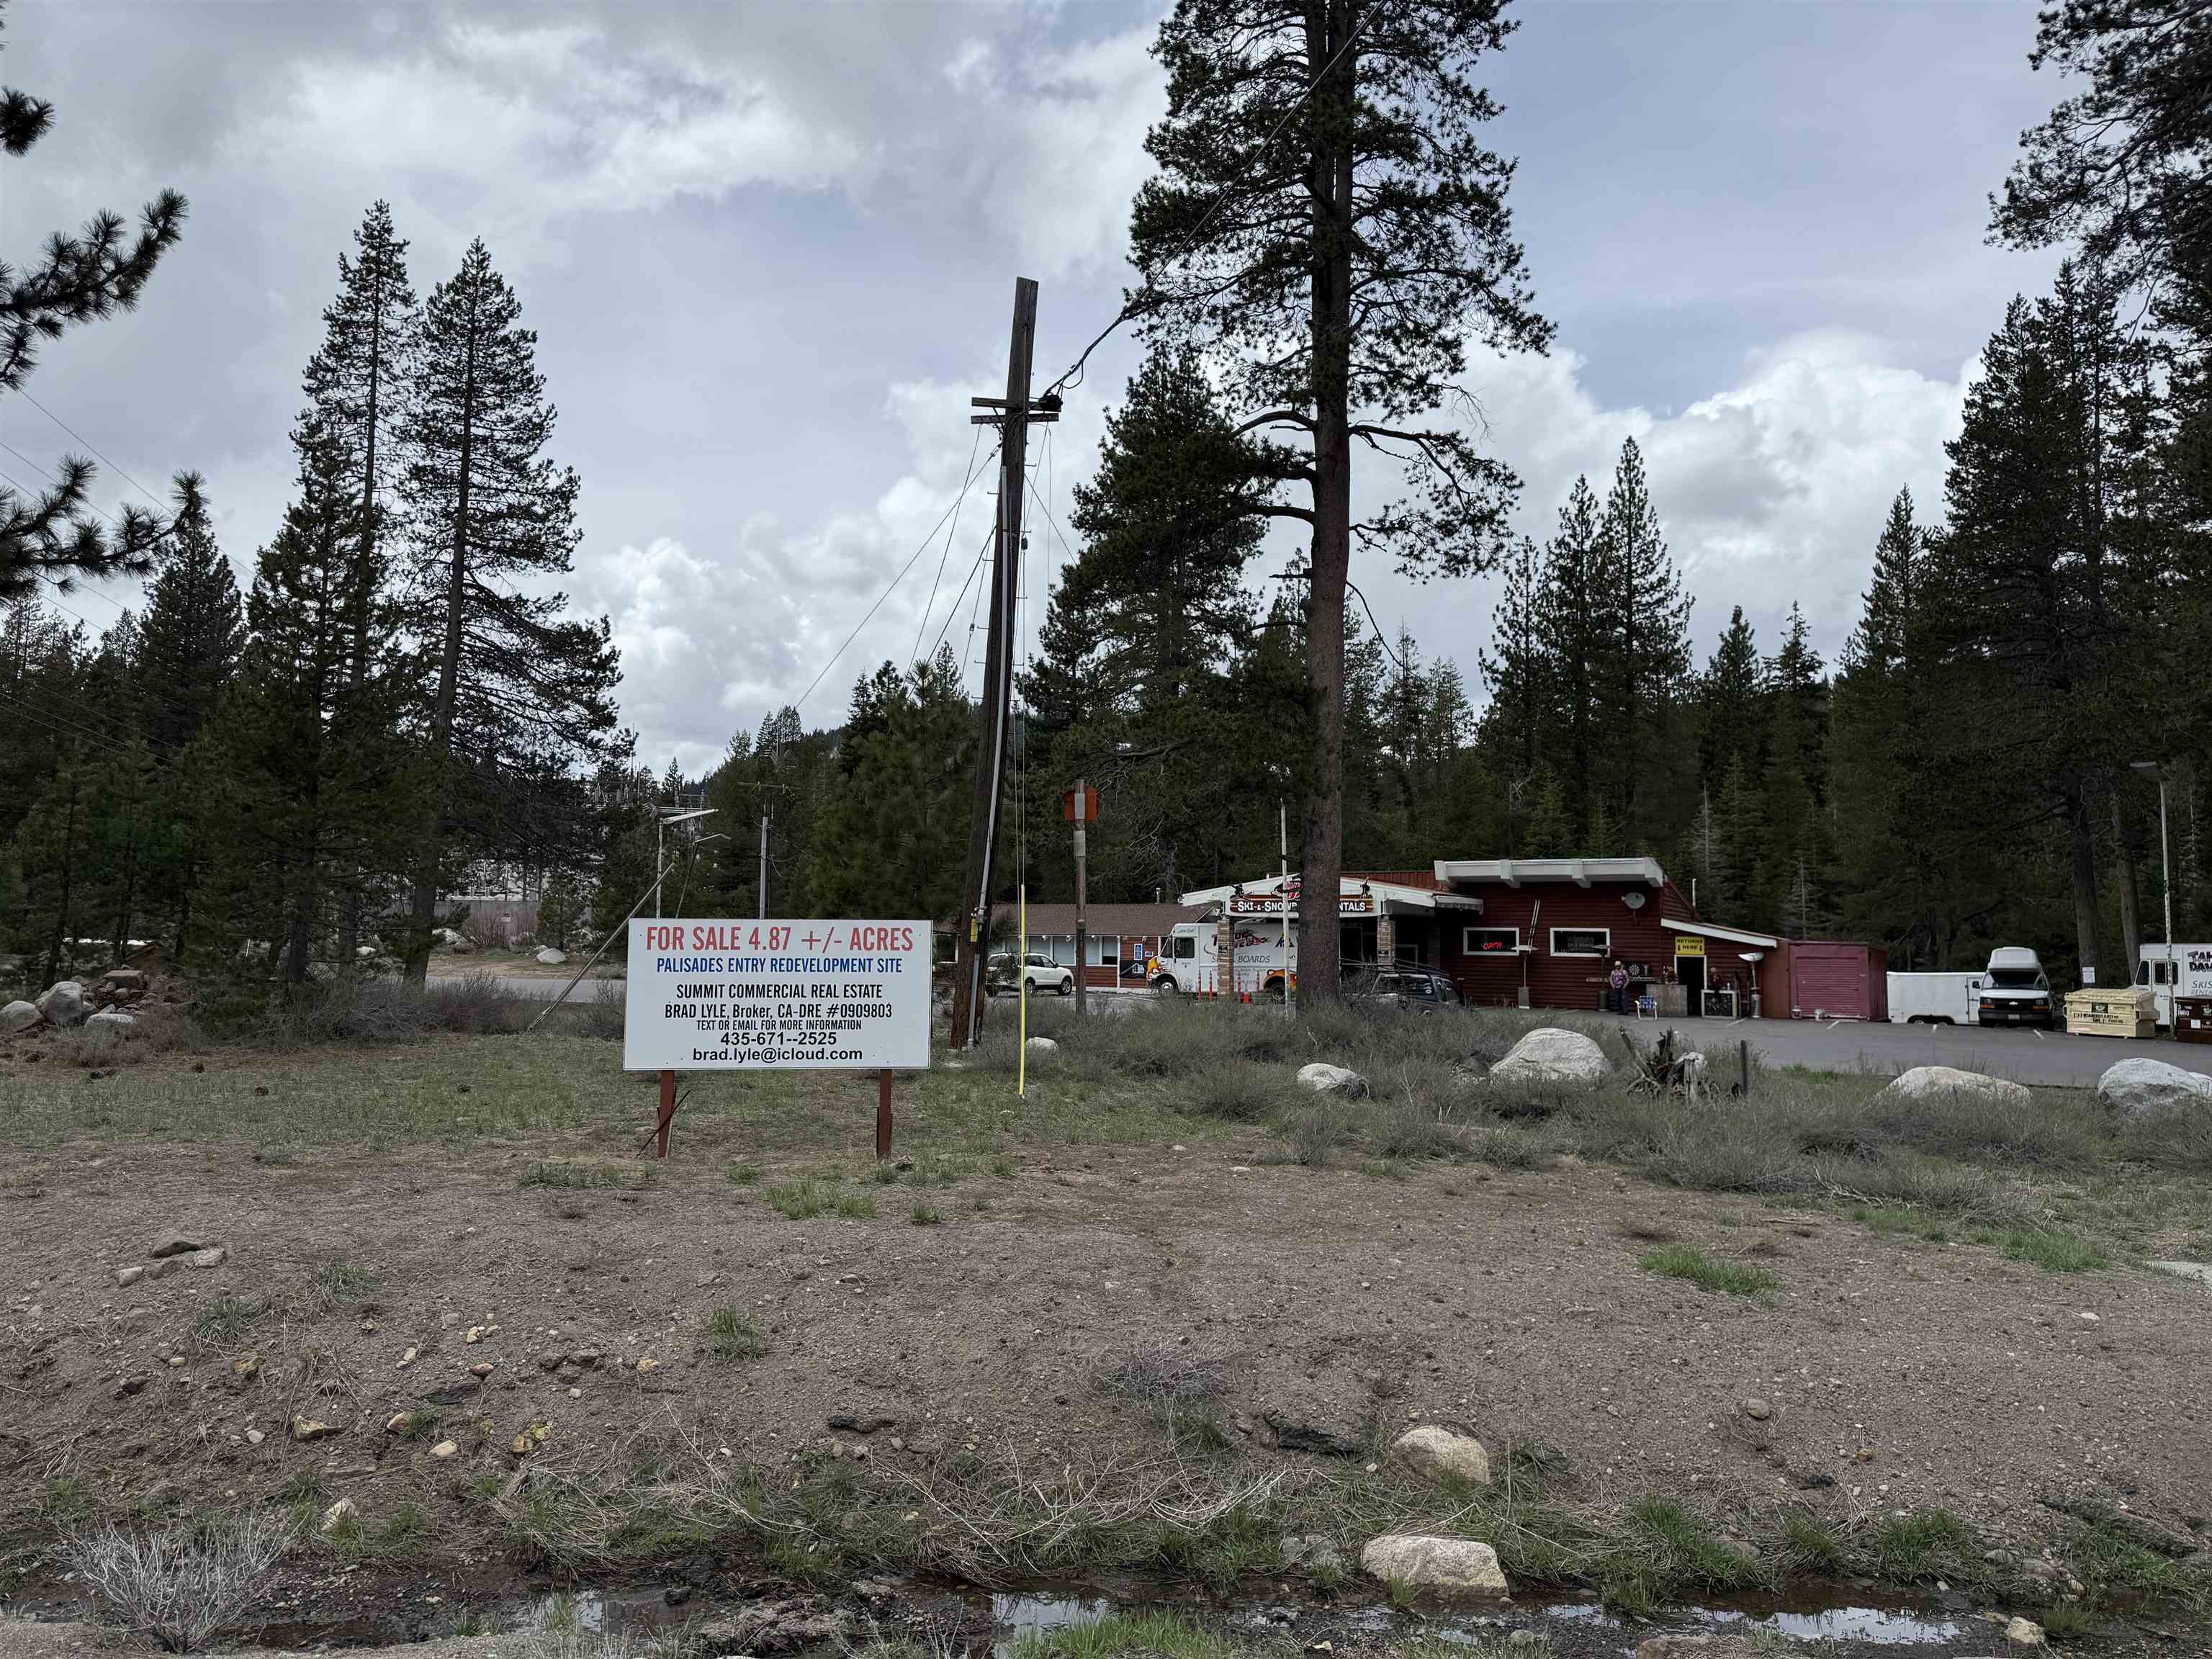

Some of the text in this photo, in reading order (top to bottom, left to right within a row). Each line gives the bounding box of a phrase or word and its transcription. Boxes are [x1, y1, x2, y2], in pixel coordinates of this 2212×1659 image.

[647, 927, 684, 950] FOR
[693, 927, 741, 950] SALE
[749, 927, 791, 950] 4.87
[850, 927, 914, 950] ACRES
[657, 958, 902, 973] PALISADES ENTRY REDEVELOPMENT SITE
[1238, 955, 1270, 963] BOARDS
[677, 984, 883, 998] SUMMIT COMMERCIAL REAL ESTATE
[665, 1004, 891, 1021] BRAD LYLE, Broker, CA-DRE #0909803
[697, 1019, 861, 1030] TEXT OR EMAIL FOR MORE INFORMATION
[721, 1032, 837, 1045] 435-671--2525
[693, 1048, 862, 1064] brad.lyle@icloud.com
